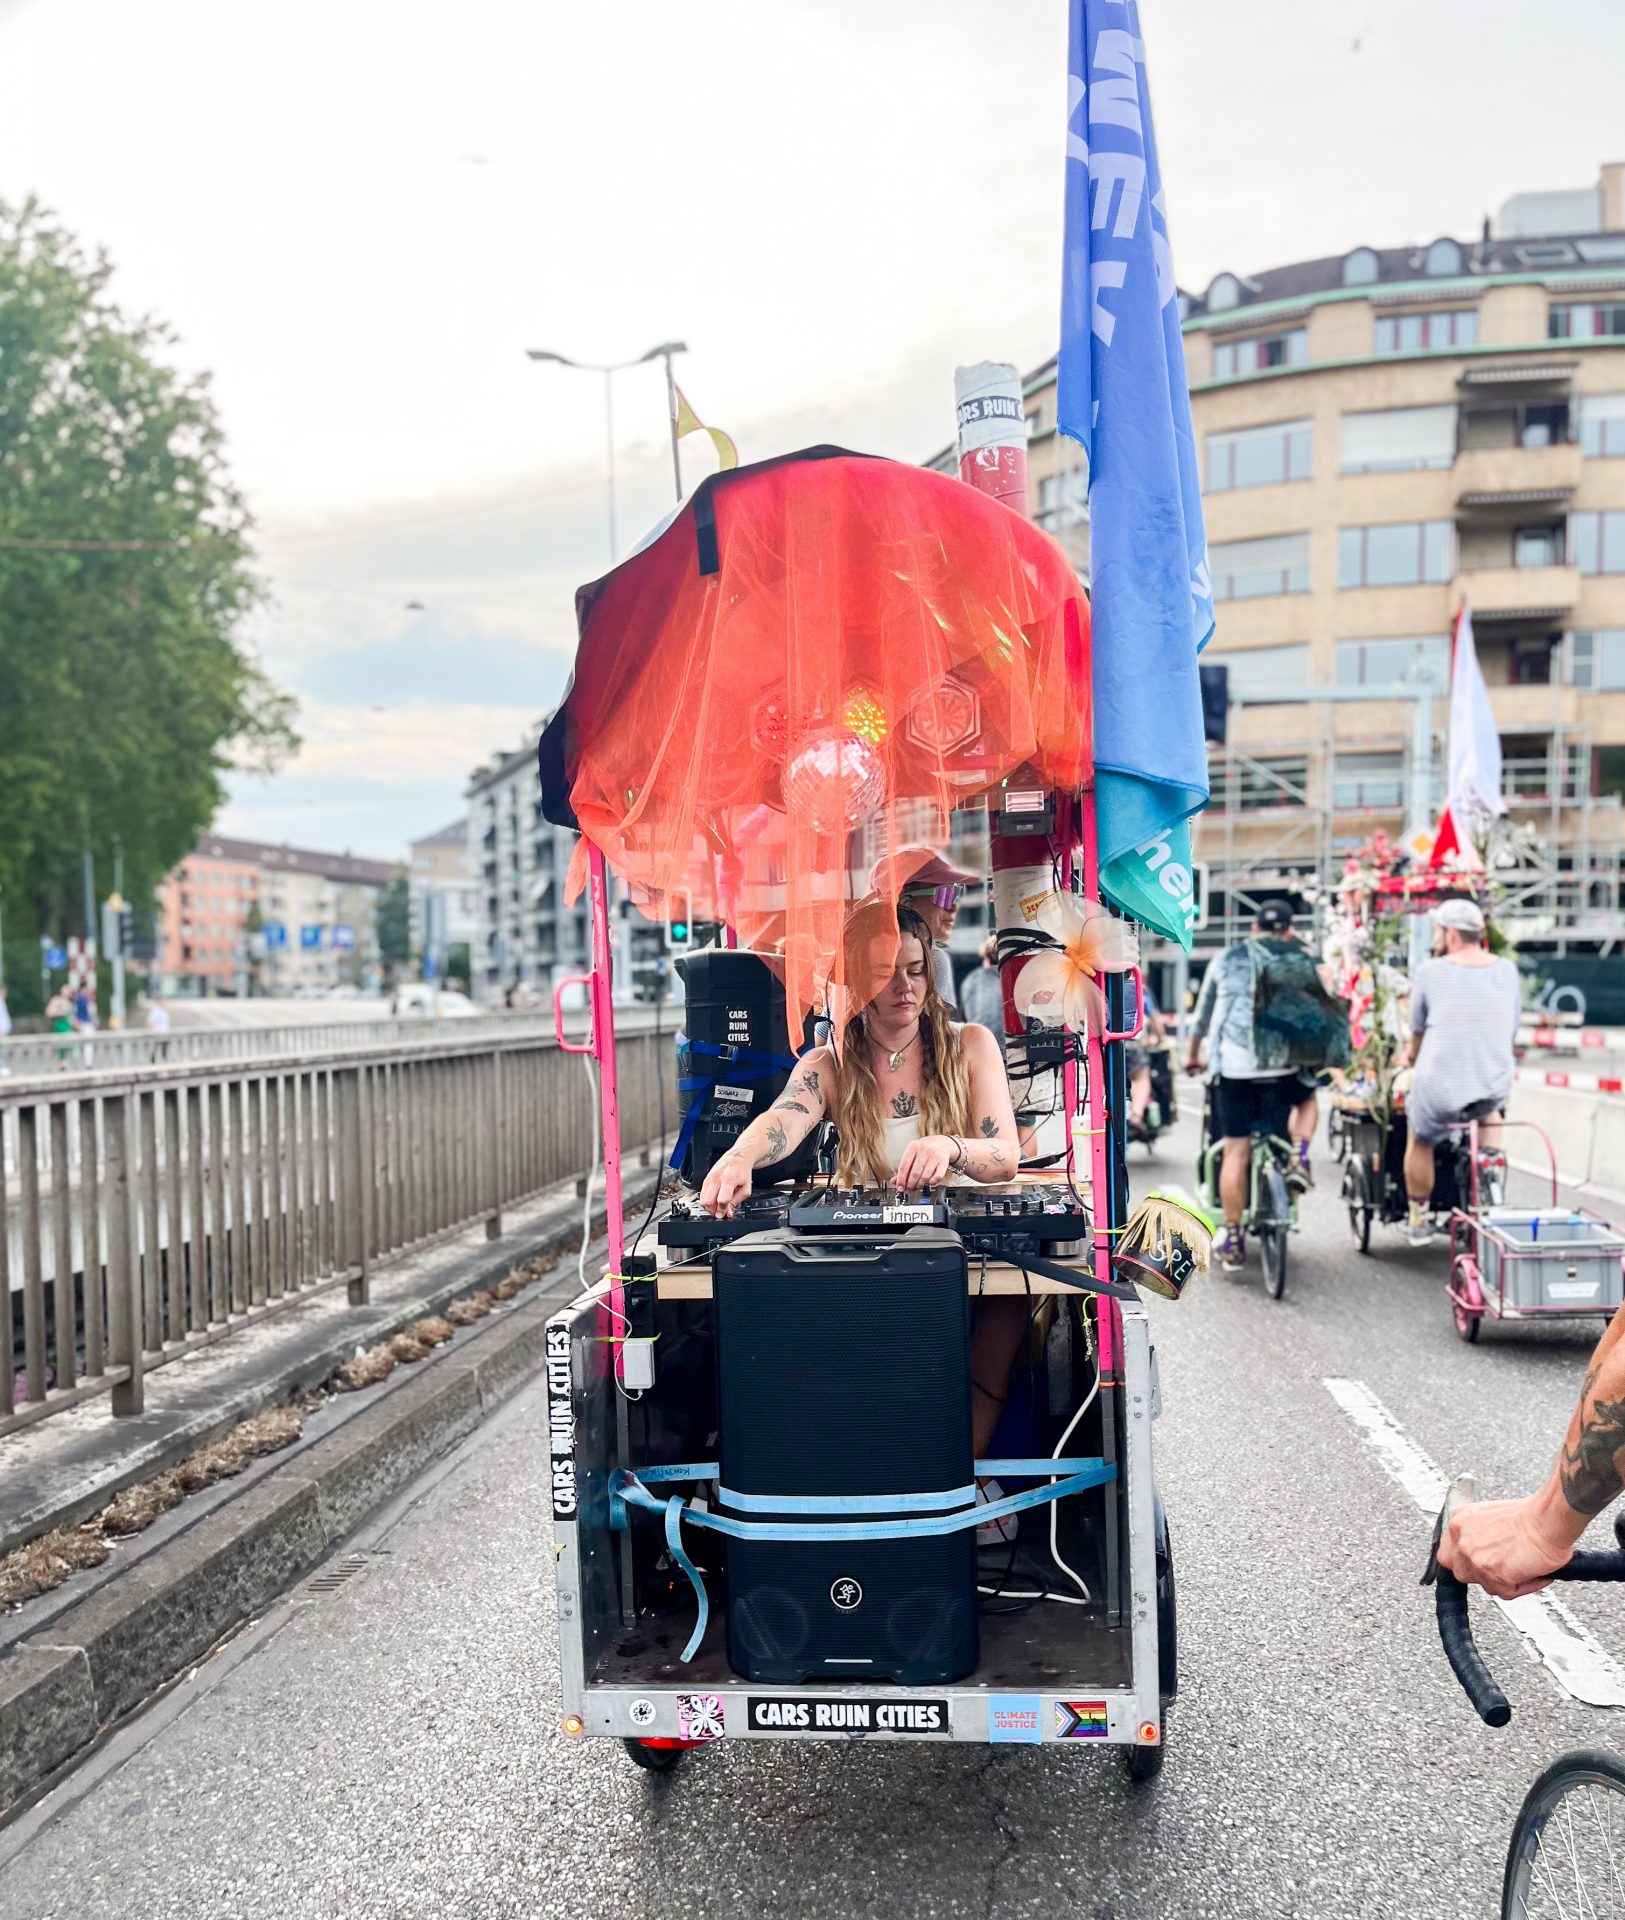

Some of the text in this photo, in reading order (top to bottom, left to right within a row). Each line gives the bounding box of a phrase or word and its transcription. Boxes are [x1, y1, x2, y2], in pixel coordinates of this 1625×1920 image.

[982, 399, 1016, 417] RUIN
[729, 1011, 748, 1019] CARS
[729, 1022, 748, 1030] RUIN
[728, 1033, 750, 1041] CITIES
[833, 1211, 882, 1219] Pioneer
[547, 1331, 576, 1514] CARS UIN CITIES
[755, 1703, 941, 1728] CARS RUIN CITIES
